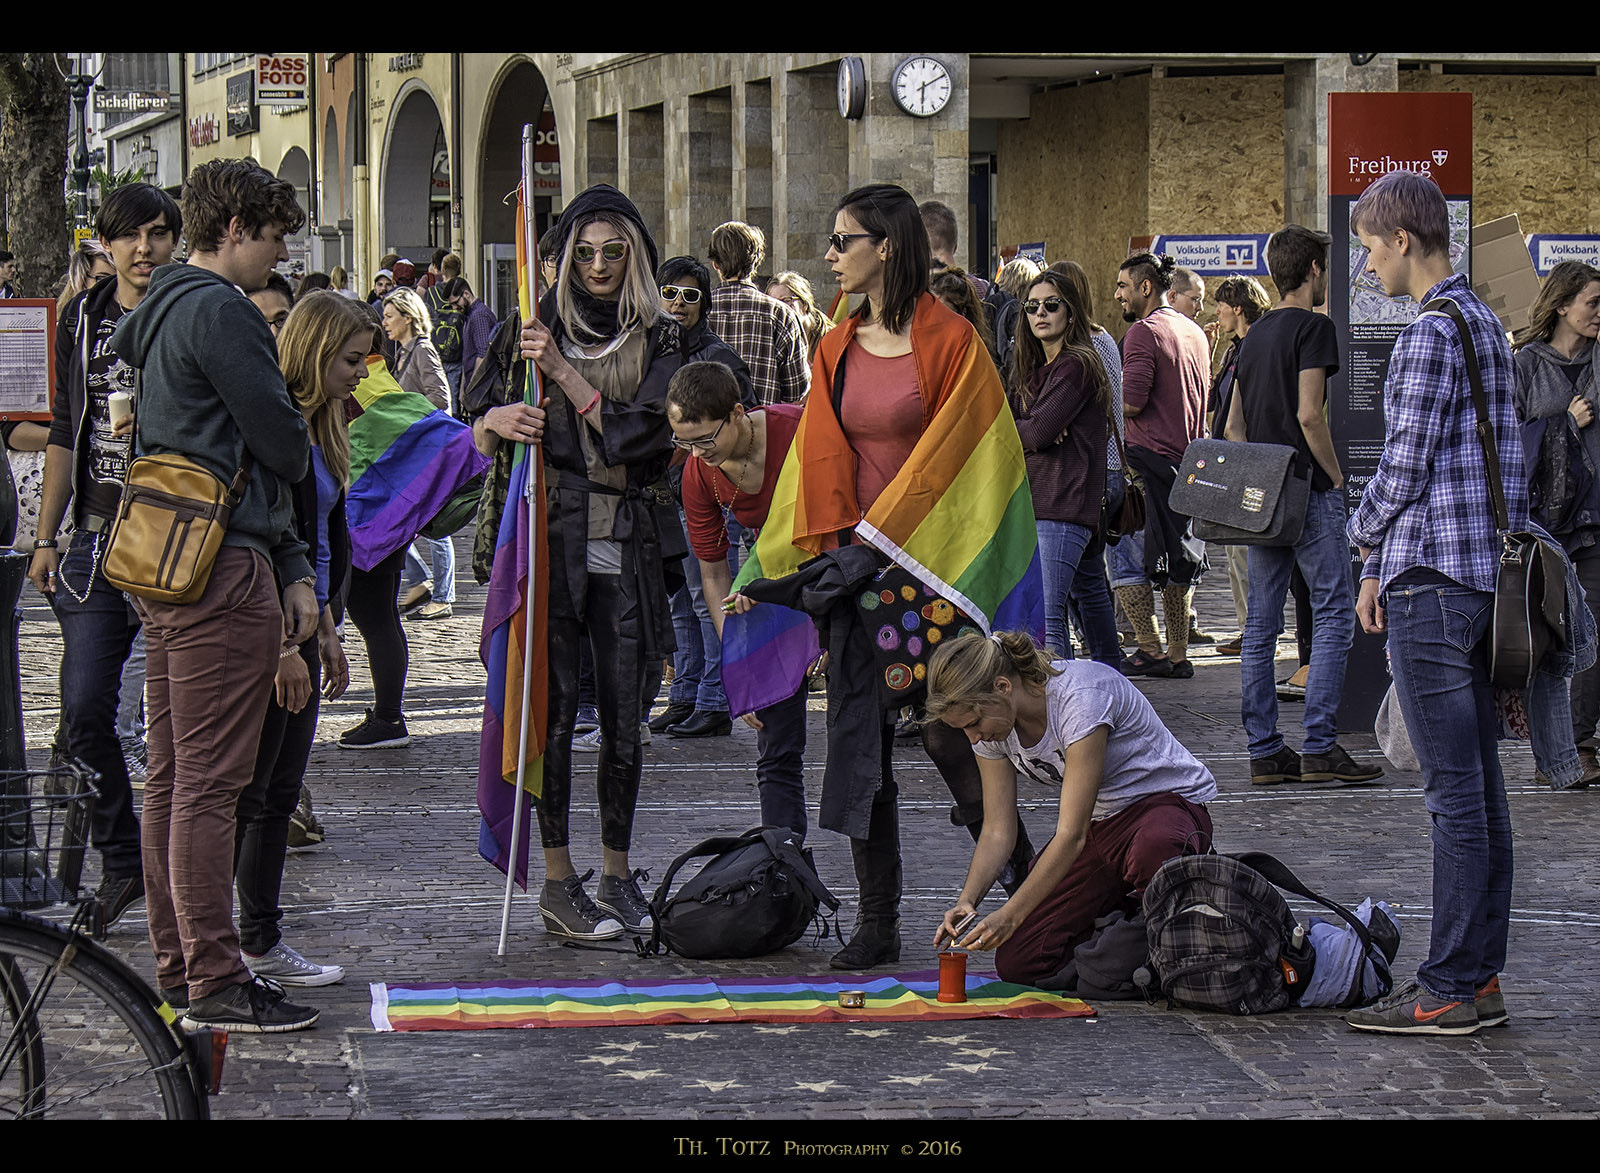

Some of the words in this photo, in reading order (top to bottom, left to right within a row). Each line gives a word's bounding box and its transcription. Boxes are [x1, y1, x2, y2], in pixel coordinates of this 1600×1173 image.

[259, 58, 305, 71] PASS
[259, 71, 306, 85] FOTO
[96, 92, 168, 111] Schafferer
[1348, 155, 1432, 179] Freiburg
[1175, 244, 1221, 254] Volksbank
[1551, 244, 1599, 255] Volksbank
[1174, 256, 1206, 268] reiburg
[1208, 256, 1221, 266] eG
